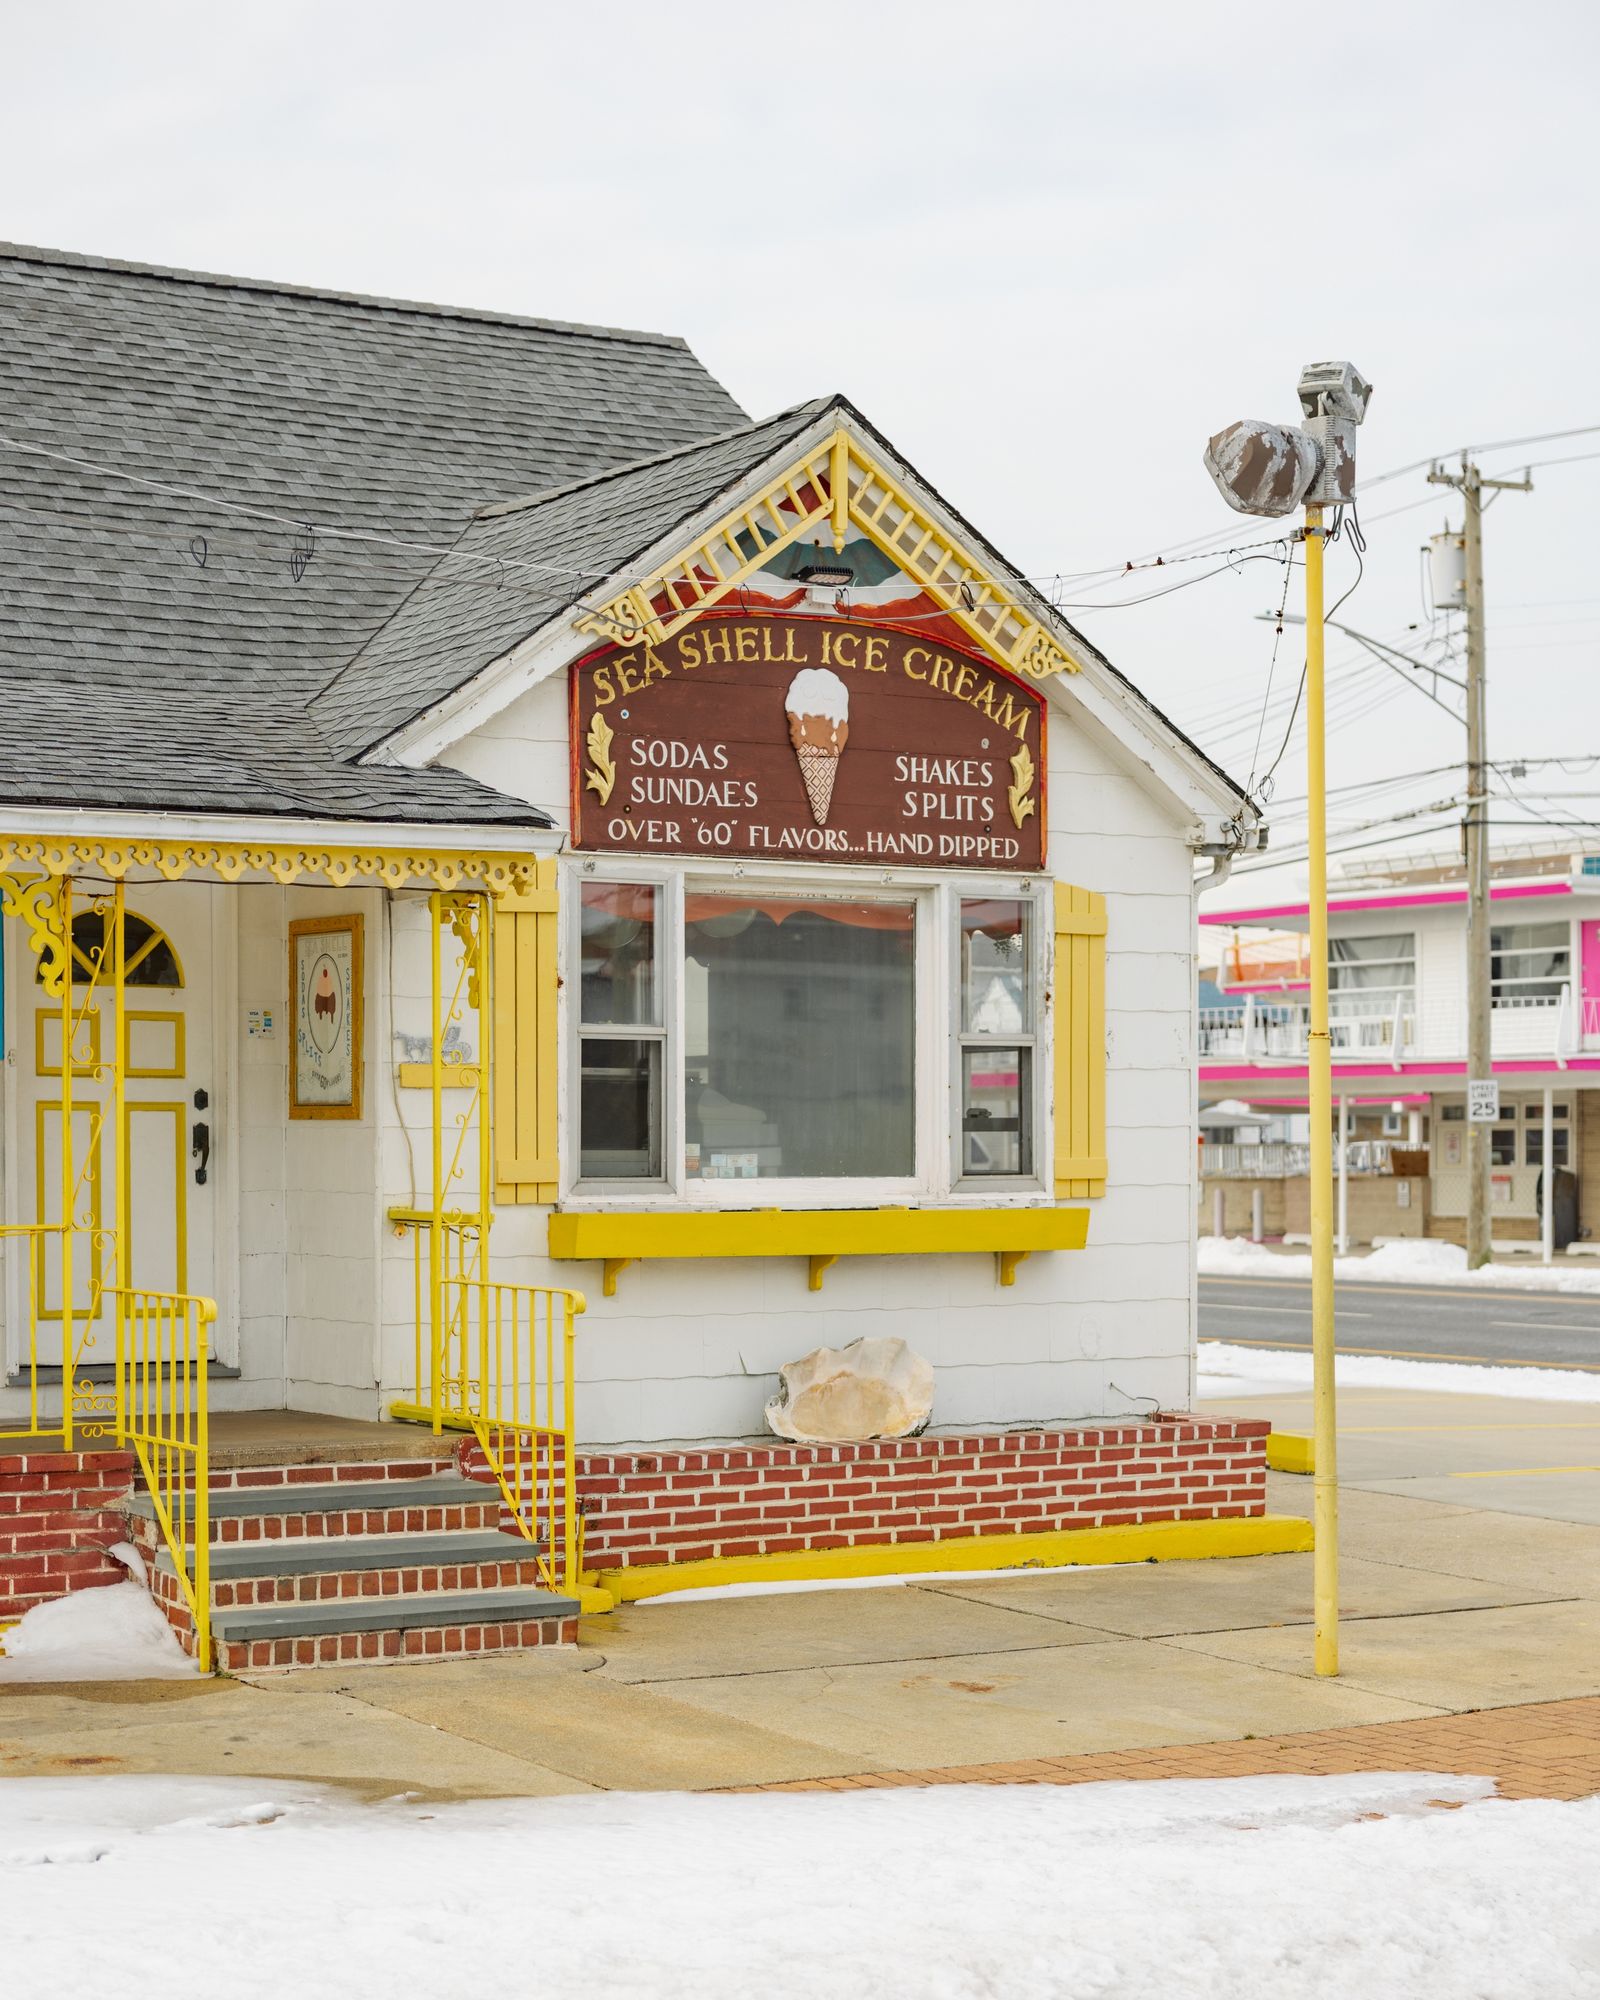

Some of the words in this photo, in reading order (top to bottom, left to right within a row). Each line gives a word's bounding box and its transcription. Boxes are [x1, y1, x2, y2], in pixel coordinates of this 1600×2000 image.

[592, 643, 672, 707] SEA
[678, 627, 808, 670] SHELL
[820, 631, 889, 673] ICE
[902, 647, 1032, 741] CREAM
[630, 739, 729, 770] SODAS
[894, 756, 993, 787] SHAKES
[630, 776, 759, 808] SUNDAES
[902, 791, 994, 822] SPLITS
[607, 818, 682, 843] OVER
[866, 831, 934, 855] HAND
[938, 834, 1020, 860] DIPPED
[298, 1028, 322, 1067] SPLITS
[1472, 1102, 1496, 1117] 25
